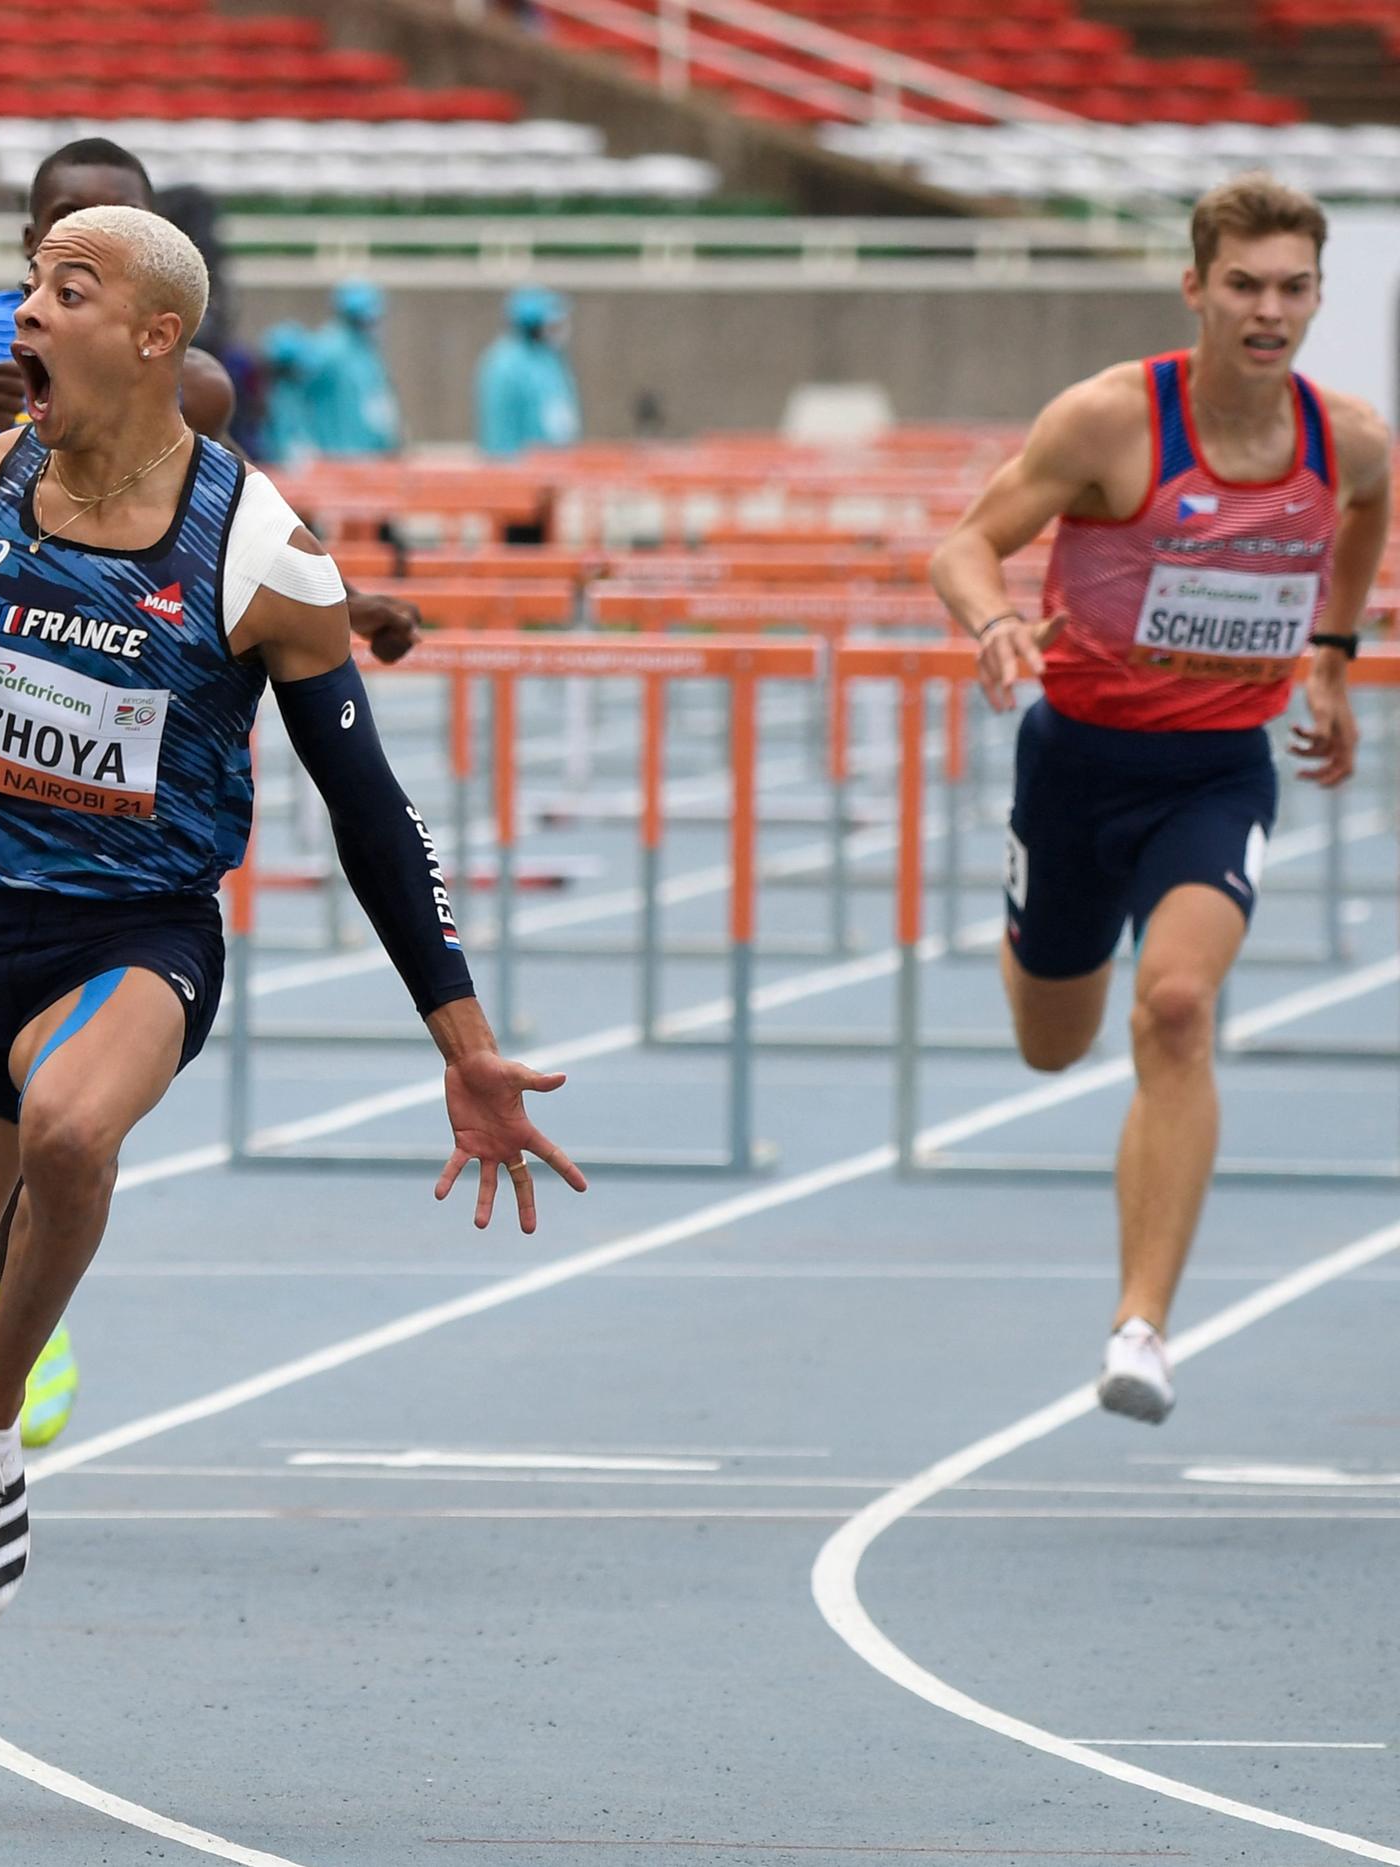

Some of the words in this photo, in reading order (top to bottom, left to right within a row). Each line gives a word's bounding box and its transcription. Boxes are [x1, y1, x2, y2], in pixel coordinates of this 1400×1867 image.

[144, 593, 183, 615] MAIF
[21, 609, 148, 658] FRANCE
[1146, 609, 1302, 651] SCHUBERT
[3, 769, 105, 809] NAIROBI
[114, 798, 141, 813] 21
